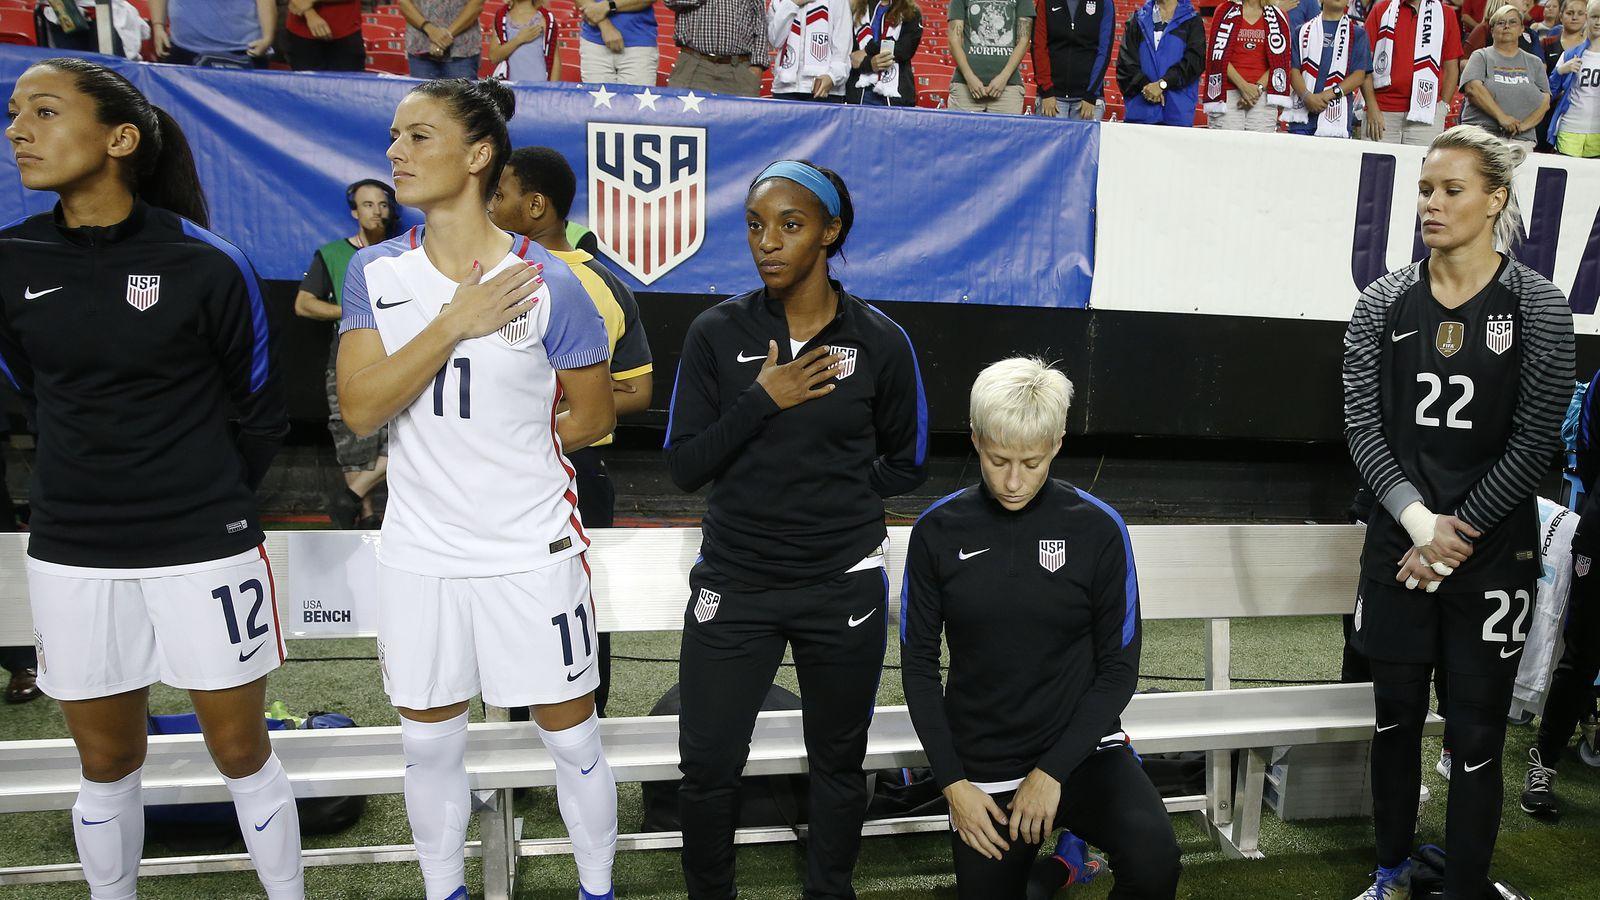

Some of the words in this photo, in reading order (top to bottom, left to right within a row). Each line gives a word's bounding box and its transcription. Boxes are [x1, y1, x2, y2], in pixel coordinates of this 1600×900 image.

[812, 34, 829, 45] USA
[1212, 22, 1234, 61] TIRE
[1580, 68, 1600, 88] 20
[1419, 81, 1433, 92] USA
[1329, 97, 1340, 107] SA
[596, 131, 698, 193] USA
[130, 276, 158, 290] USA
[1488, 322, 1511, 335] USA
[433, 357, 471, 419] 11
[1415, 372, 1475, 429] 22
[1041, 541, 1063, 554] USA
[1578, 555, 1591, 565] USA
[701, 590, 719, 605] USA
[211, 578, 269, 645] 12
[303, 600, 323, 610] USA
[303, 610, 351, 623] BENCH
[1482, 589, 1530, 642] 22
[551, 603, 592, 667] 11
